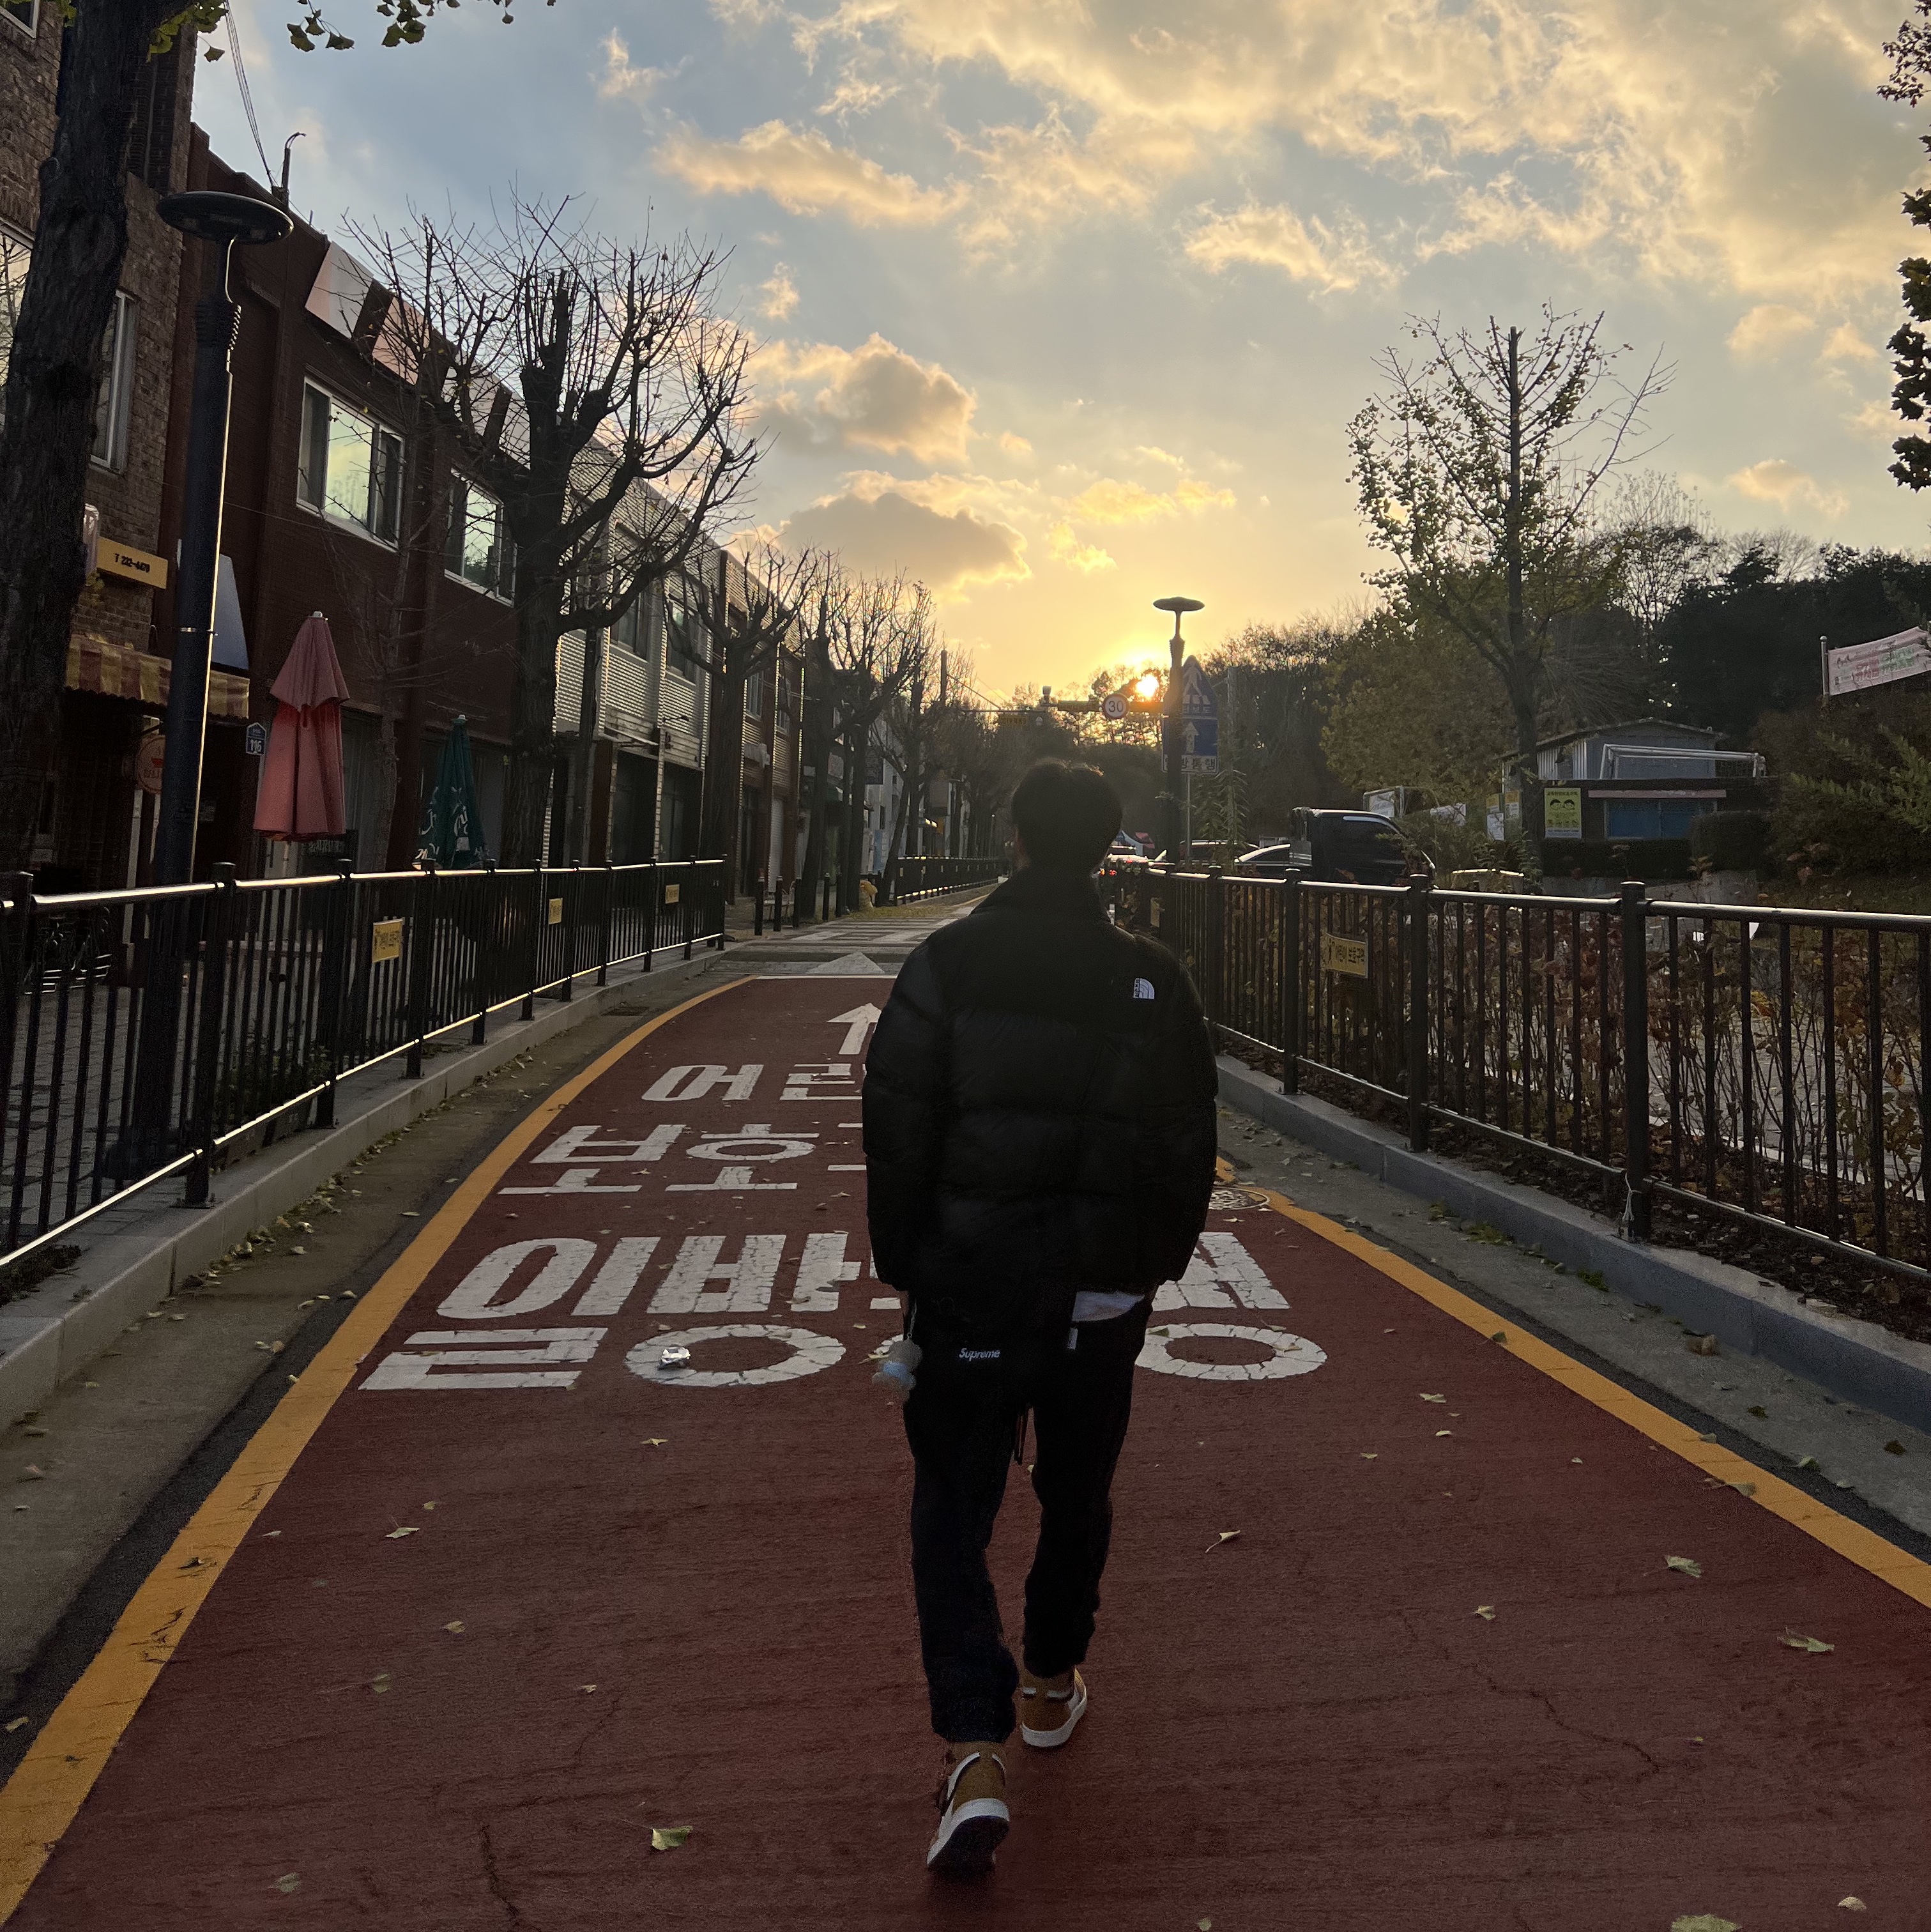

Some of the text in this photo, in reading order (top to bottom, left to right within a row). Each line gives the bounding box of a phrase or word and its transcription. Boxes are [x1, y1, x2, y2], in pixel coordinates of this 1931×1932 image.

[1108, 700, 1124, 713] 30
[1182, 704, 1211, 714] 단보도
[1164, 758, 1215, 770] 방통행
[641, 1064, 866, 1101] 어린
[498, 1124, 867, 1195] 보호
[358, 1232, 1328, 1390] 일방행
[959, 1347, 1001, 1361] Supreme
